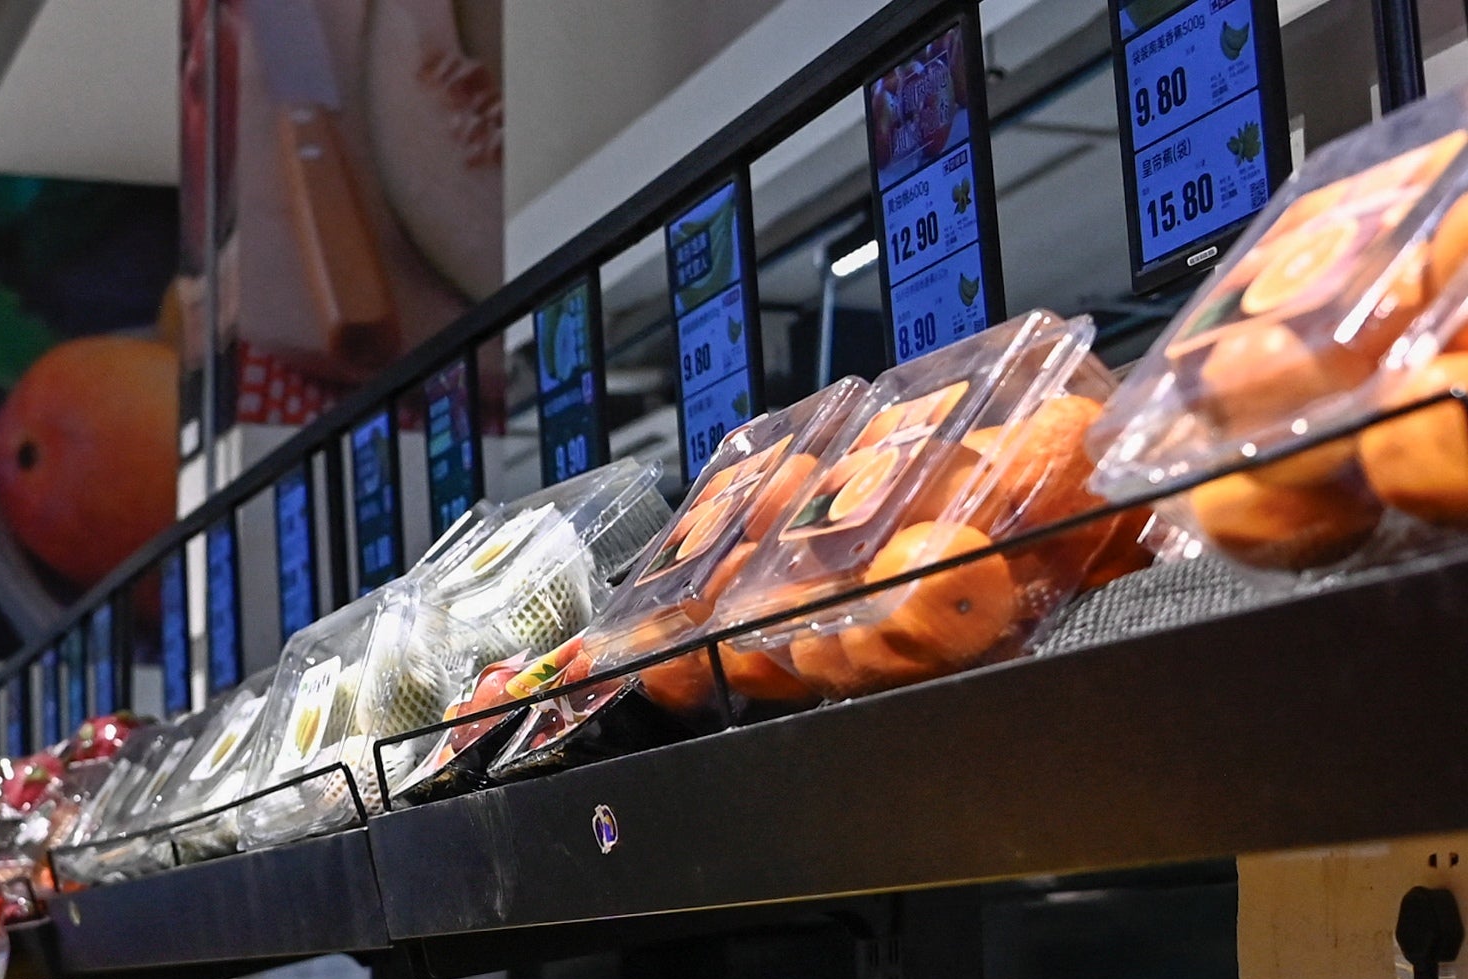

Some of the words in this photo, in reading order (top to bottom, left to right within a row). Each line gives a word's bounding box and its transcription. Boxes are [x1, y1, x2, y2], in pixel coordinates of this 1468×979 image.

[1136, 66, 1187, 127] 9.80
[1142, 138, 1191, 178] 皇帝蕉(袋)
[1147, 173, 1214, 237] 15.80
[891, 211, 939, 265] 12.90
[898, 312, 936, 359] 8.90
[684, 343, 710, 381] 9.80
